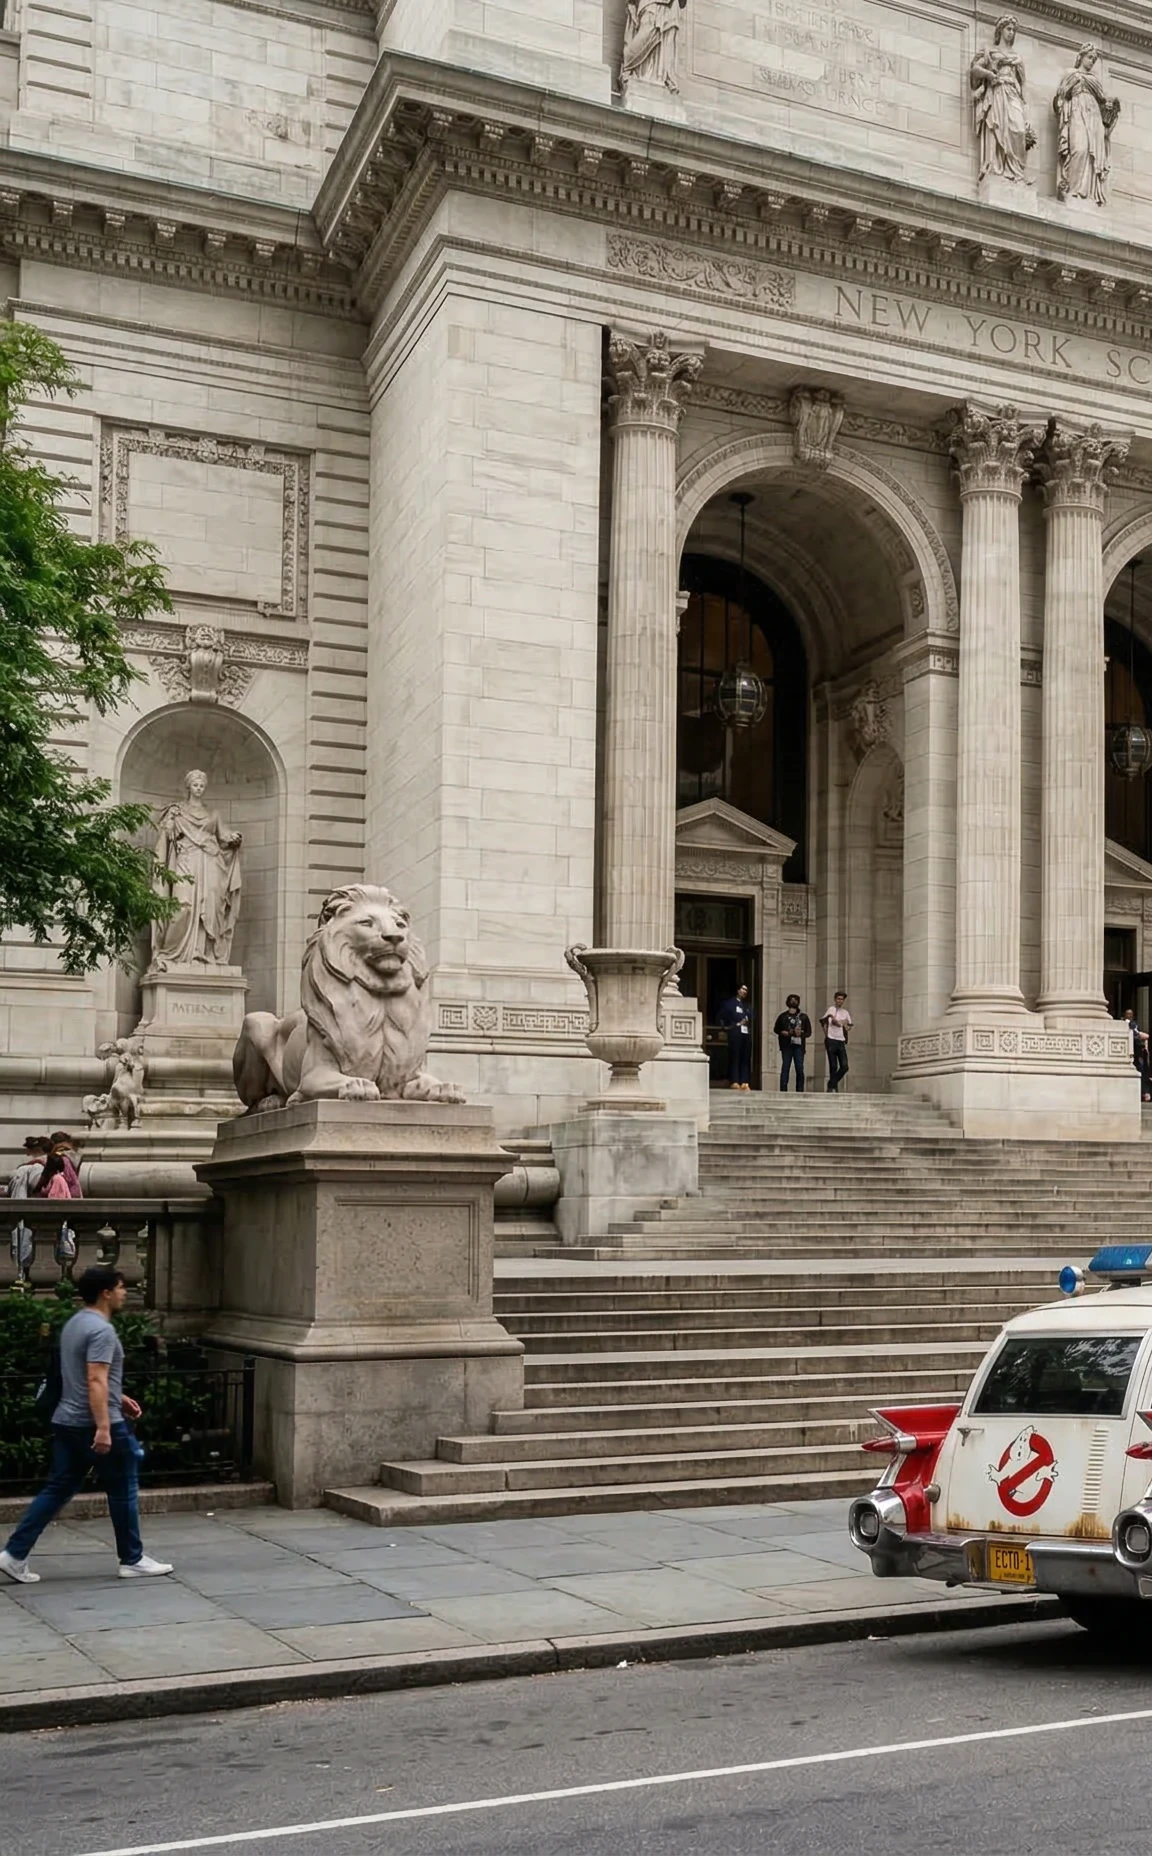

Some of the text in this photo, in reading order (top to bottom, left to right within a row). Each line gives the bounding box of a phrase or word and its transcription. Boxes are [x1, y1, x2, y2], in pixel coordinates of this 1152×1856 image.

[835, 285, 932, 336] NEW
[962, 314, 1073, 368] YORK
[995, 1549, 1031, 1571] ECTO-1
